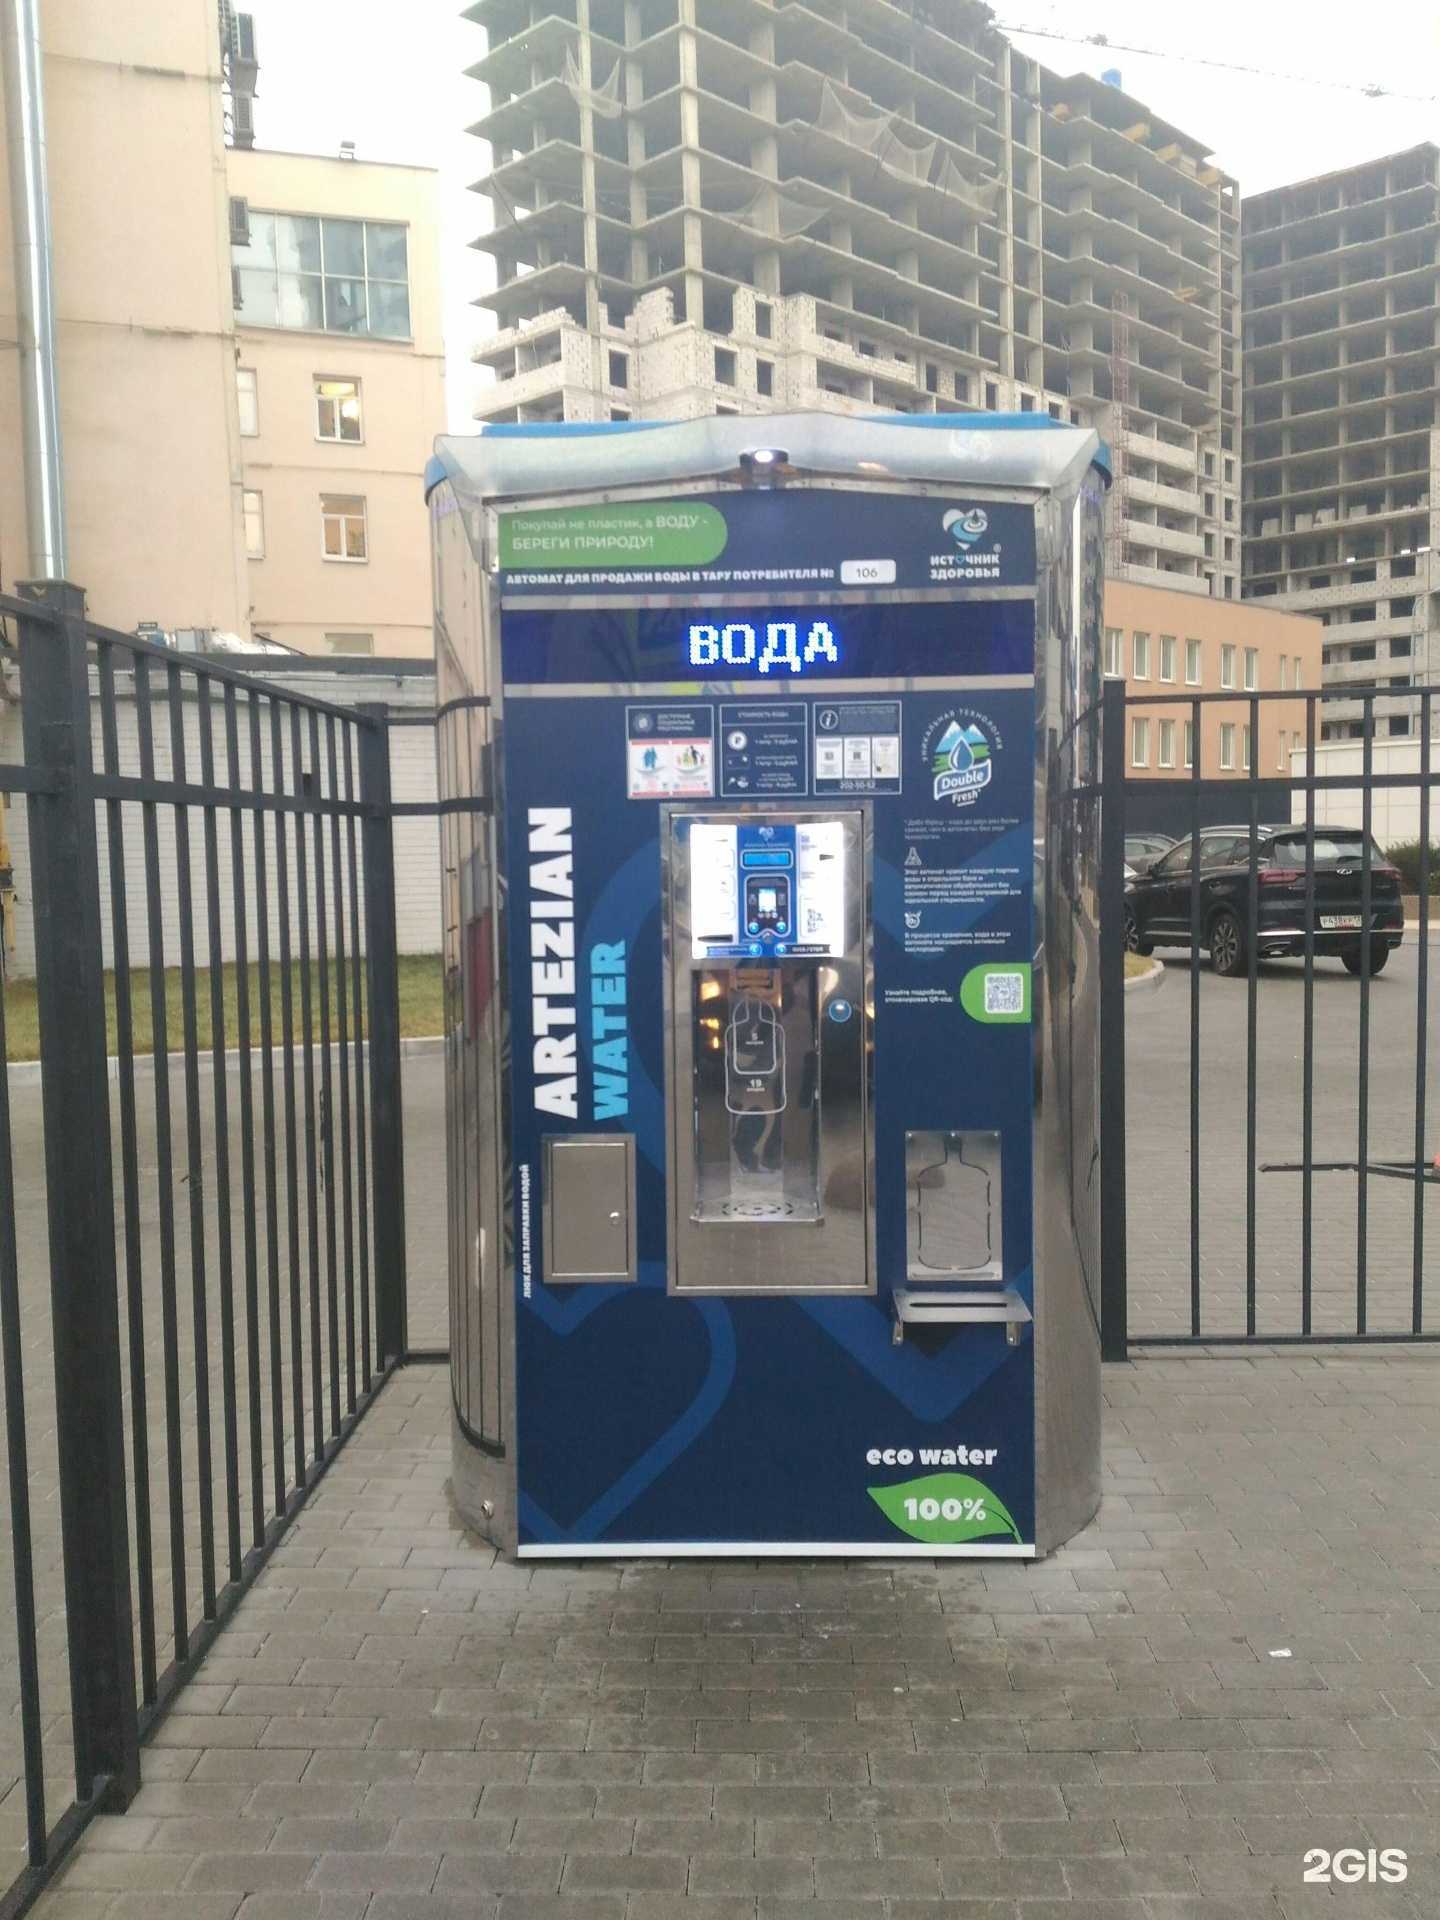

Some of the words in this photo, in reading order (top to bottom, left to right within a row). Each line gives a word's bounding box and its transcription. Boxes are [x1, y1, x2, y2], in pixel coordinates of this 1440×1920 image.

[511, 517, 566, 532] Покупай
[569, 521, 585, 530] не
[645, 520, 653, 528] а
[655, 514, 699, 529] ВОДУ
[512, 536, 570, 550] БЕРЕГИ
[574, 534, 654, 550] ПРИРОДУ!
[506, 573, 563, 585] АВТОМАТ
[564, 573, 590, 585] ДЛЯ
[591, 571, 653, 584] ПРОДАЖИ
[655, 571, 690, 583] ВОДЫ
[692, 571, 701, 582] В
[701, 570, 732, 582] ТАРУ
[733, 568, 818, 580] ПОТРЕБИТЕЛЯ
[856, 567, 878, 578] 106
[930, 567, 1000, 580] ЗДОРОВЬЯ
[689, 622, 838, 673] ВОДА
[941, 770, 985, 790] Double
[528, 807, 578, 1120] ARTEZIAN
[590, 939, 629, 1121] WATER
[519, 1164, 530, 1200] ВОДОЙ
[521, 1201, 531, 1252] ЗАПРАВКИ
[522, 1253, 532, 1274] ДЛЯ
[523, 1274, 532, 1299] ЛЮК
[866, 1448, 914, 1466] eco
[919, 1444, 998, 1466] water
[903, 1498, 987, 1521] 100%
